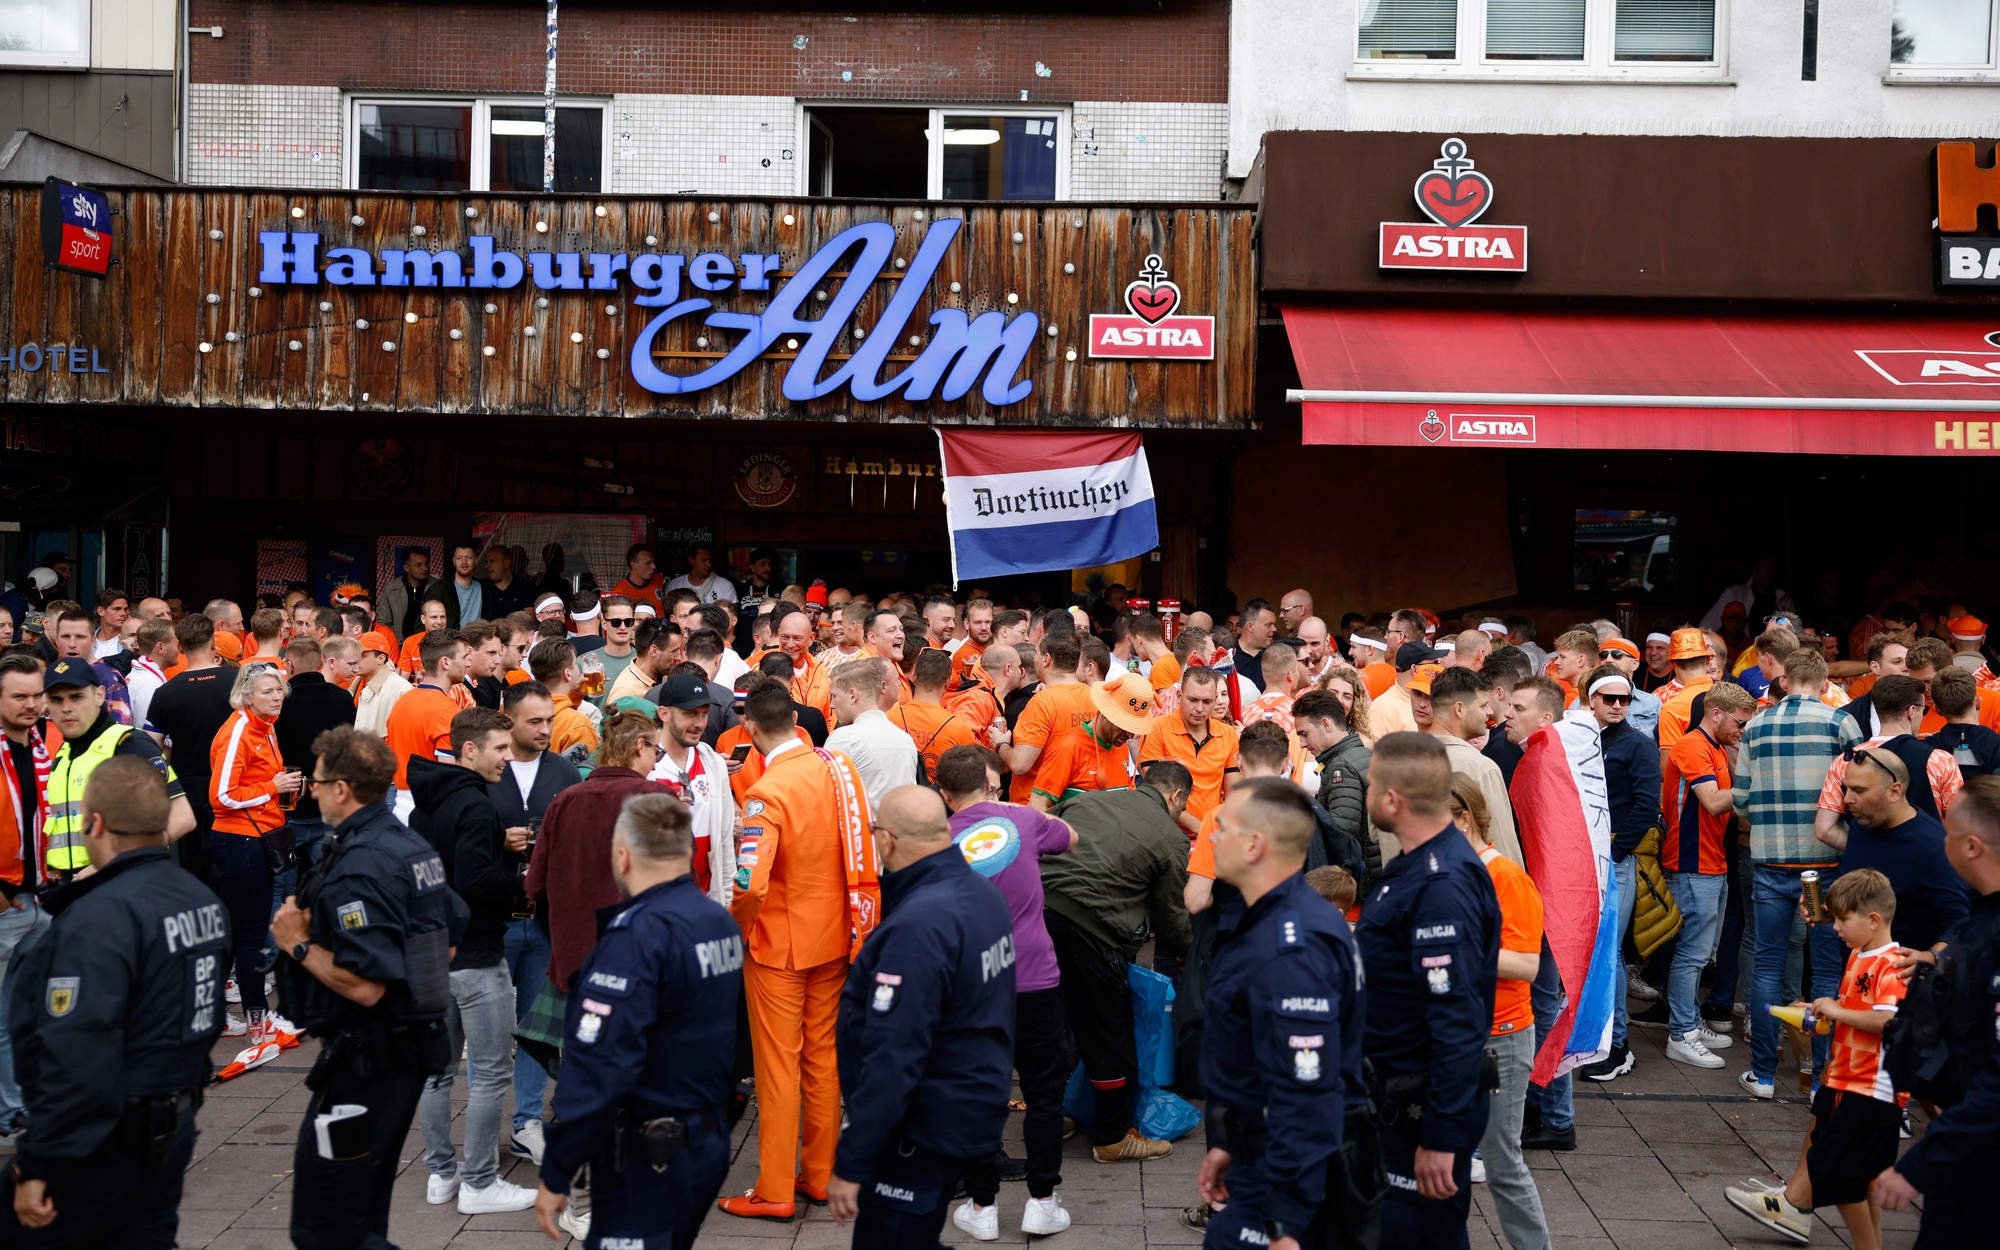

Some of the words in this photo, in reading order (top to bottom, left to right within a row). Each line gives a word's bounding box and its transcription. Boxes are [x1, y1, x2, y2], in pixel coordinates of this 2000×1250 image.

[73, 193, 97, 227] sky
[70, 240, 101, 261] sport
[1392, 234, 1515, 259] ASTRA
[259, 230, 781, 307] Hamburger
[630, 217, 1039, 405] Alm
[1100, 327, 1204, 347] ASTRA
[0, 346, 110, 373] HOTEL
[2, 411, 73, 455] TABLE
[93, 426, 159, 463] DANCE
[1457, 420, 1529, 435] ASTRA
[738, 452, 792, 475] ERDINGER
[972, 478, 1130, 517] Doetinchen
[1416, 924, 1456, 940] POLICJA
[195, 955, 217, 984] BP
[588, 971, 628, 991] POLICJA
[194, 980, 216, 1009] RZ
[1281, 997, 1330, 1013] POLICJA
[875, 1182, 914, 1202] POLICJA
